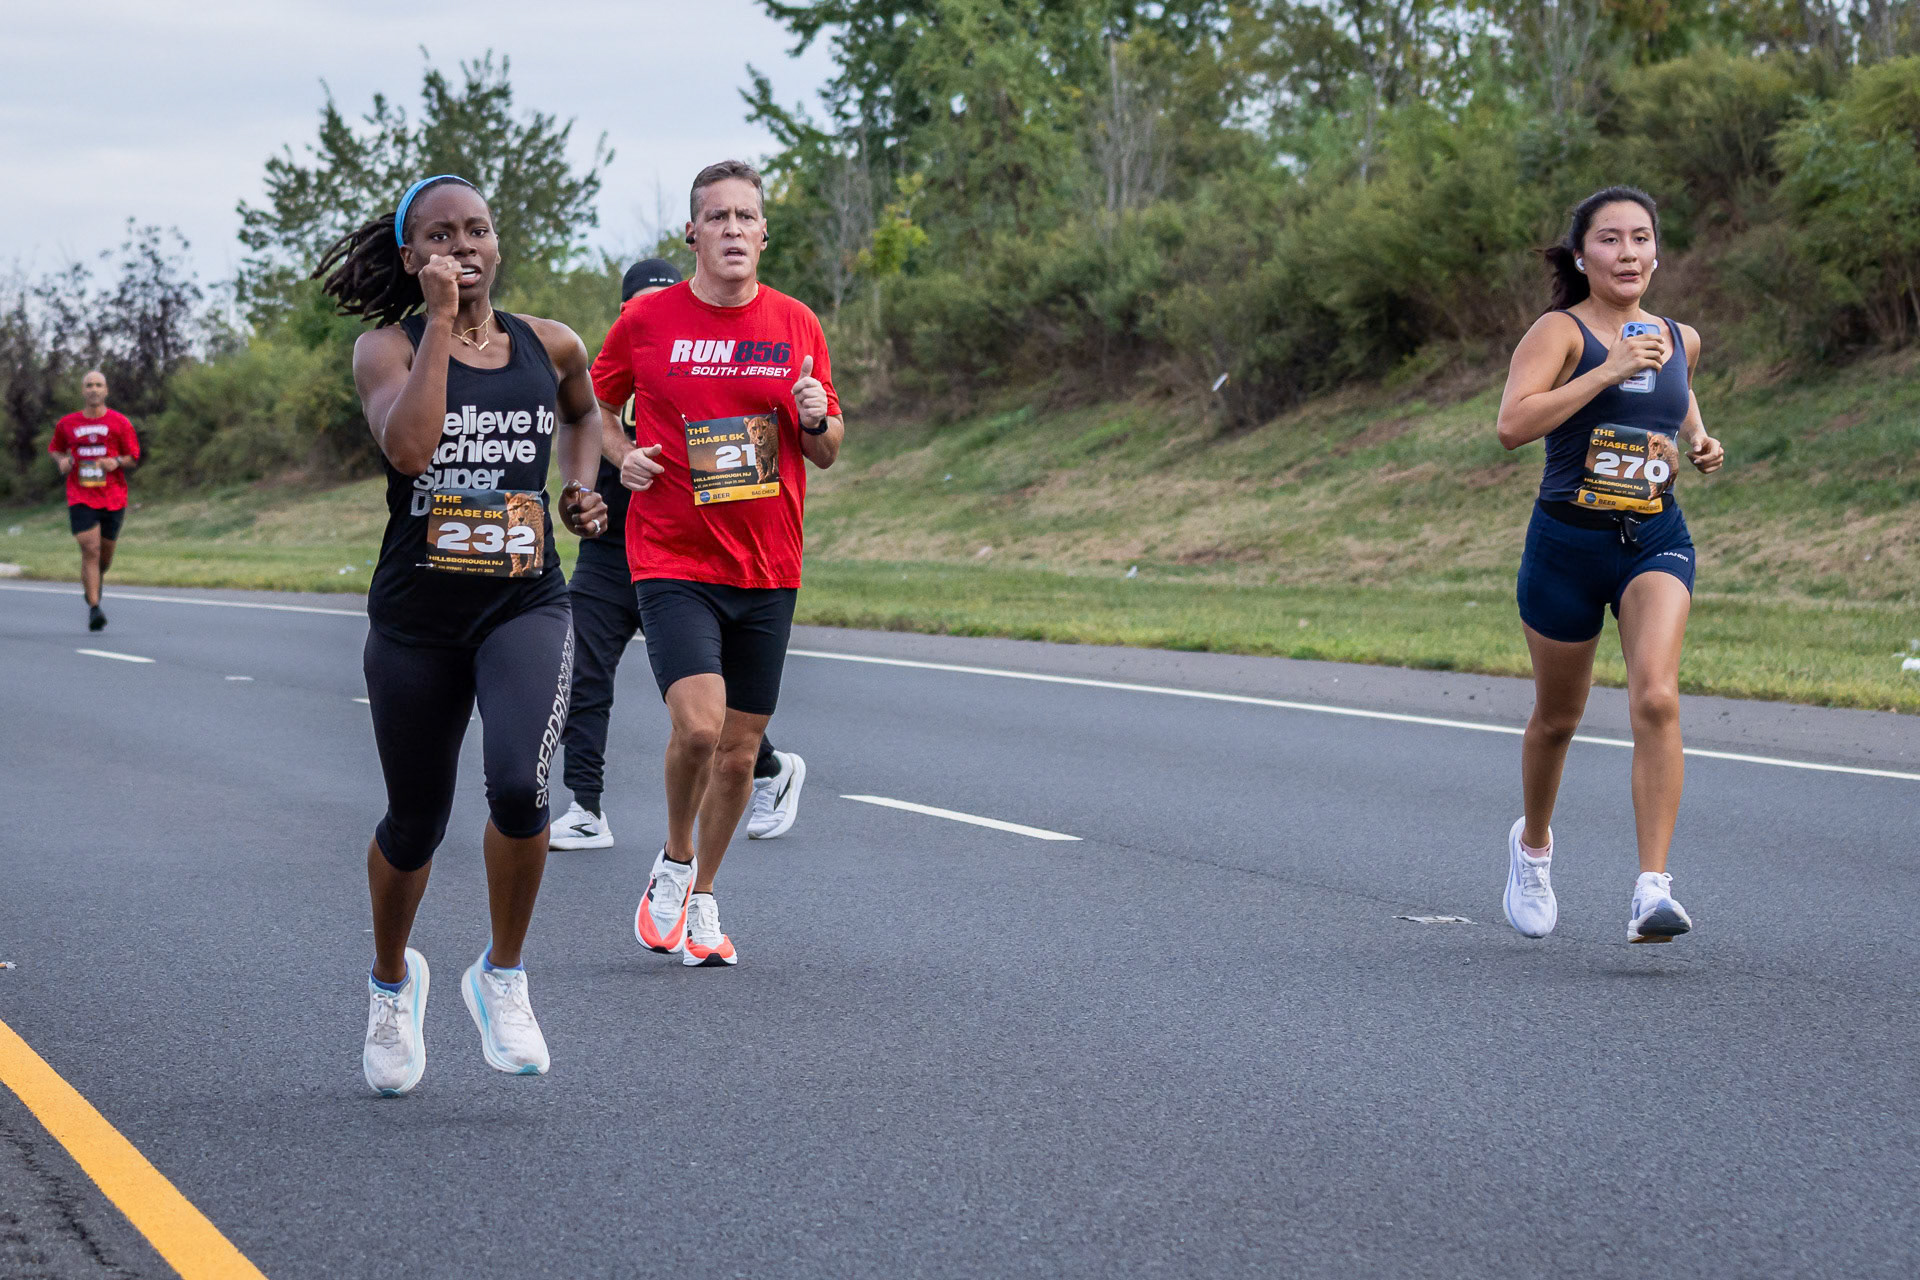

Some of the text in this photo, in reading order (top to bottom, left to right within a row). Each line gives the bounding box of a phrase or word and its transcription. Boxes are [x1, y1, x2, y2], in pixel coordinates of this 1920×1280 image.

[691, 366, 791, 377] SOUTH JERSEY
[443, 405, 555, 436] elieve to
[687, 426, 710, 435] THE
[1593, 428, 1615, 437] THE
[688, 433, 745, 446] CHASE 5K
[1591, 439, 1645, 453] CHASE 5K
[715, 443, 757, 469] 21
[1593, 451, 1670, 483] 270
[433, 494, 462, 503] THE
[1598, 498, 1616, 506] BEER
[432, 507, 504, 519] CHASE 5K
[437, 521, 536, 554] 232
[535, 684, 567, 808] SUPERDRY
